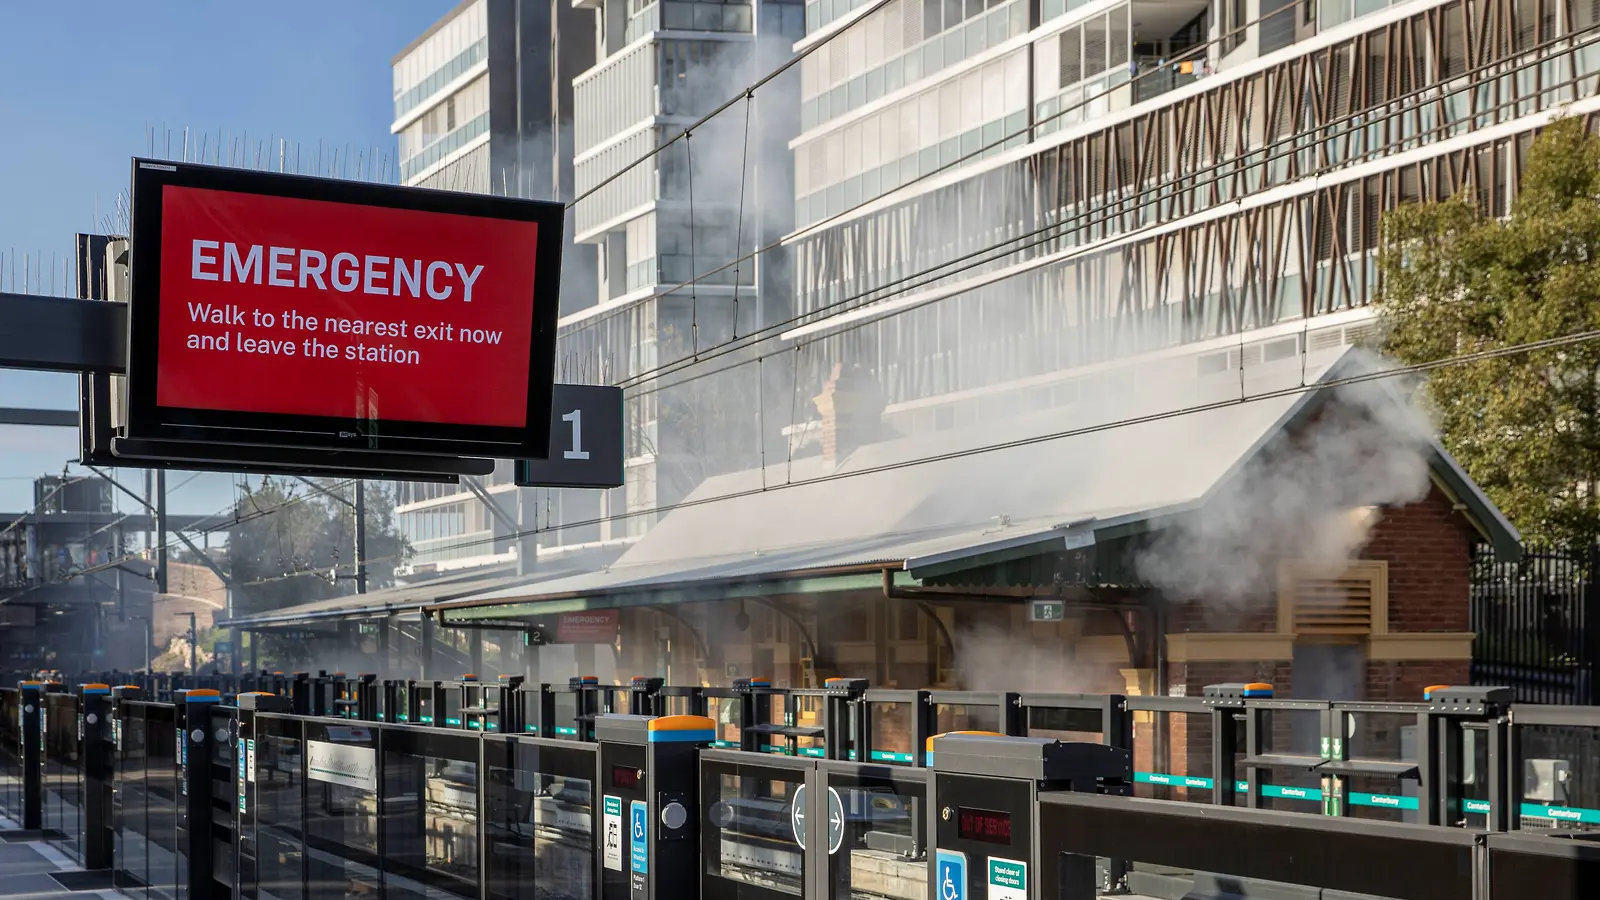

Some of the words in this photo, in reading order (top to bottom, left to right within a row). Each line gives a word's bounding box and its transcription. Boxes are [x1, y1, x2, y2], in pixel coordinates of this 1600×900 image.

[191, 239, 485, 303] EMERGENCY
[187, 301, 246, 326] Walk
[252, 308, 275, 328] to
[281, 309, 319, 331] the
[324, 316, 408, 338] nearest
[413, 321, 454, 341] exit
[459, 327, 503, 345] now
[186, 331, 230, 351] and
[236, 332, 296, 356] leave
[302, 337, 339, 359] the
[344, 342, 420, 365] station
[562, 409, 590, 460] 1
[533, 631, 541, 642] 2
[1281, 787, 1306, 798] Canterbury
[1371, 795, 1399, 807] Canterbury
[1547, 808, 1582, 820] Canterbury
